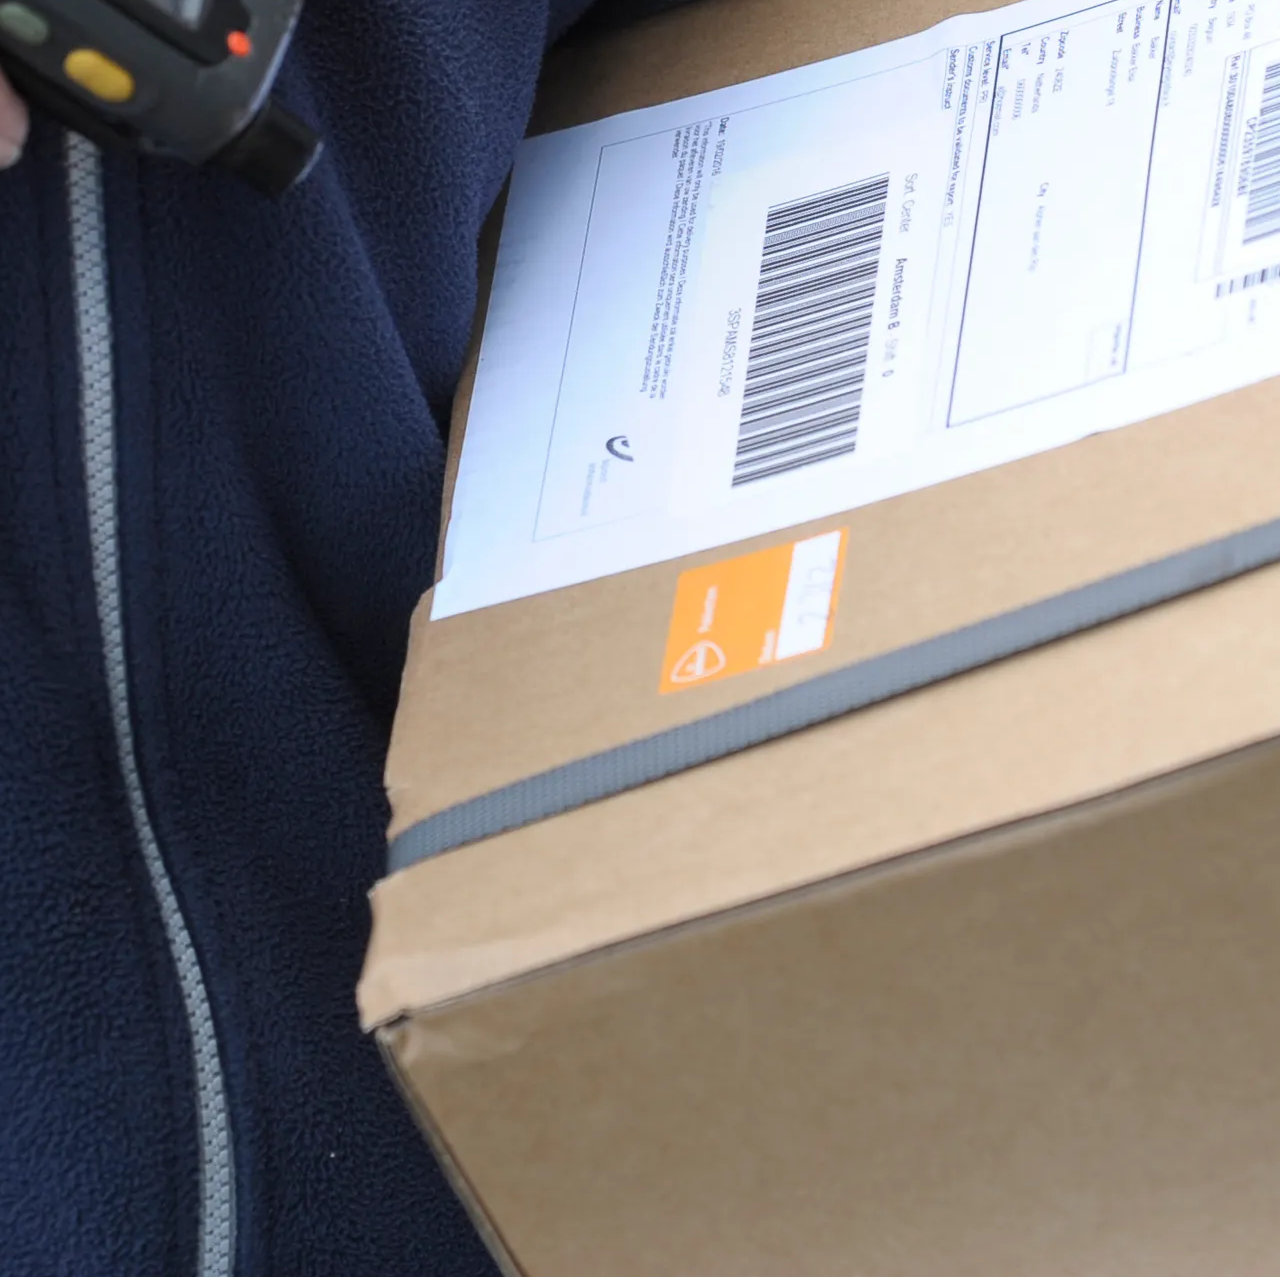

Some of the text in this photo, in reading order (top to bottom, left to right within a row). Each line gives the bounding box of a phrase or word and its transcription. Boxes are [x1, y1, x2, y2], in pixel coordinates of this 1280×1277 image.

[1115, 11, 1127, 34] Street
[1132, 5, 1145, 39] Business
[982, 39, 996, 67] Service
[1035, 35, 1050, 65] Country
[1056, 30, 1069, 59] Zipcode
[946, 47, 960, 81] Sender's
[964, 45, 978, 77] Customs
[958, 78, 972, 116] documents
[889, 257, 907, 319] Amsterdam
[886, 320, 900, 330] B
